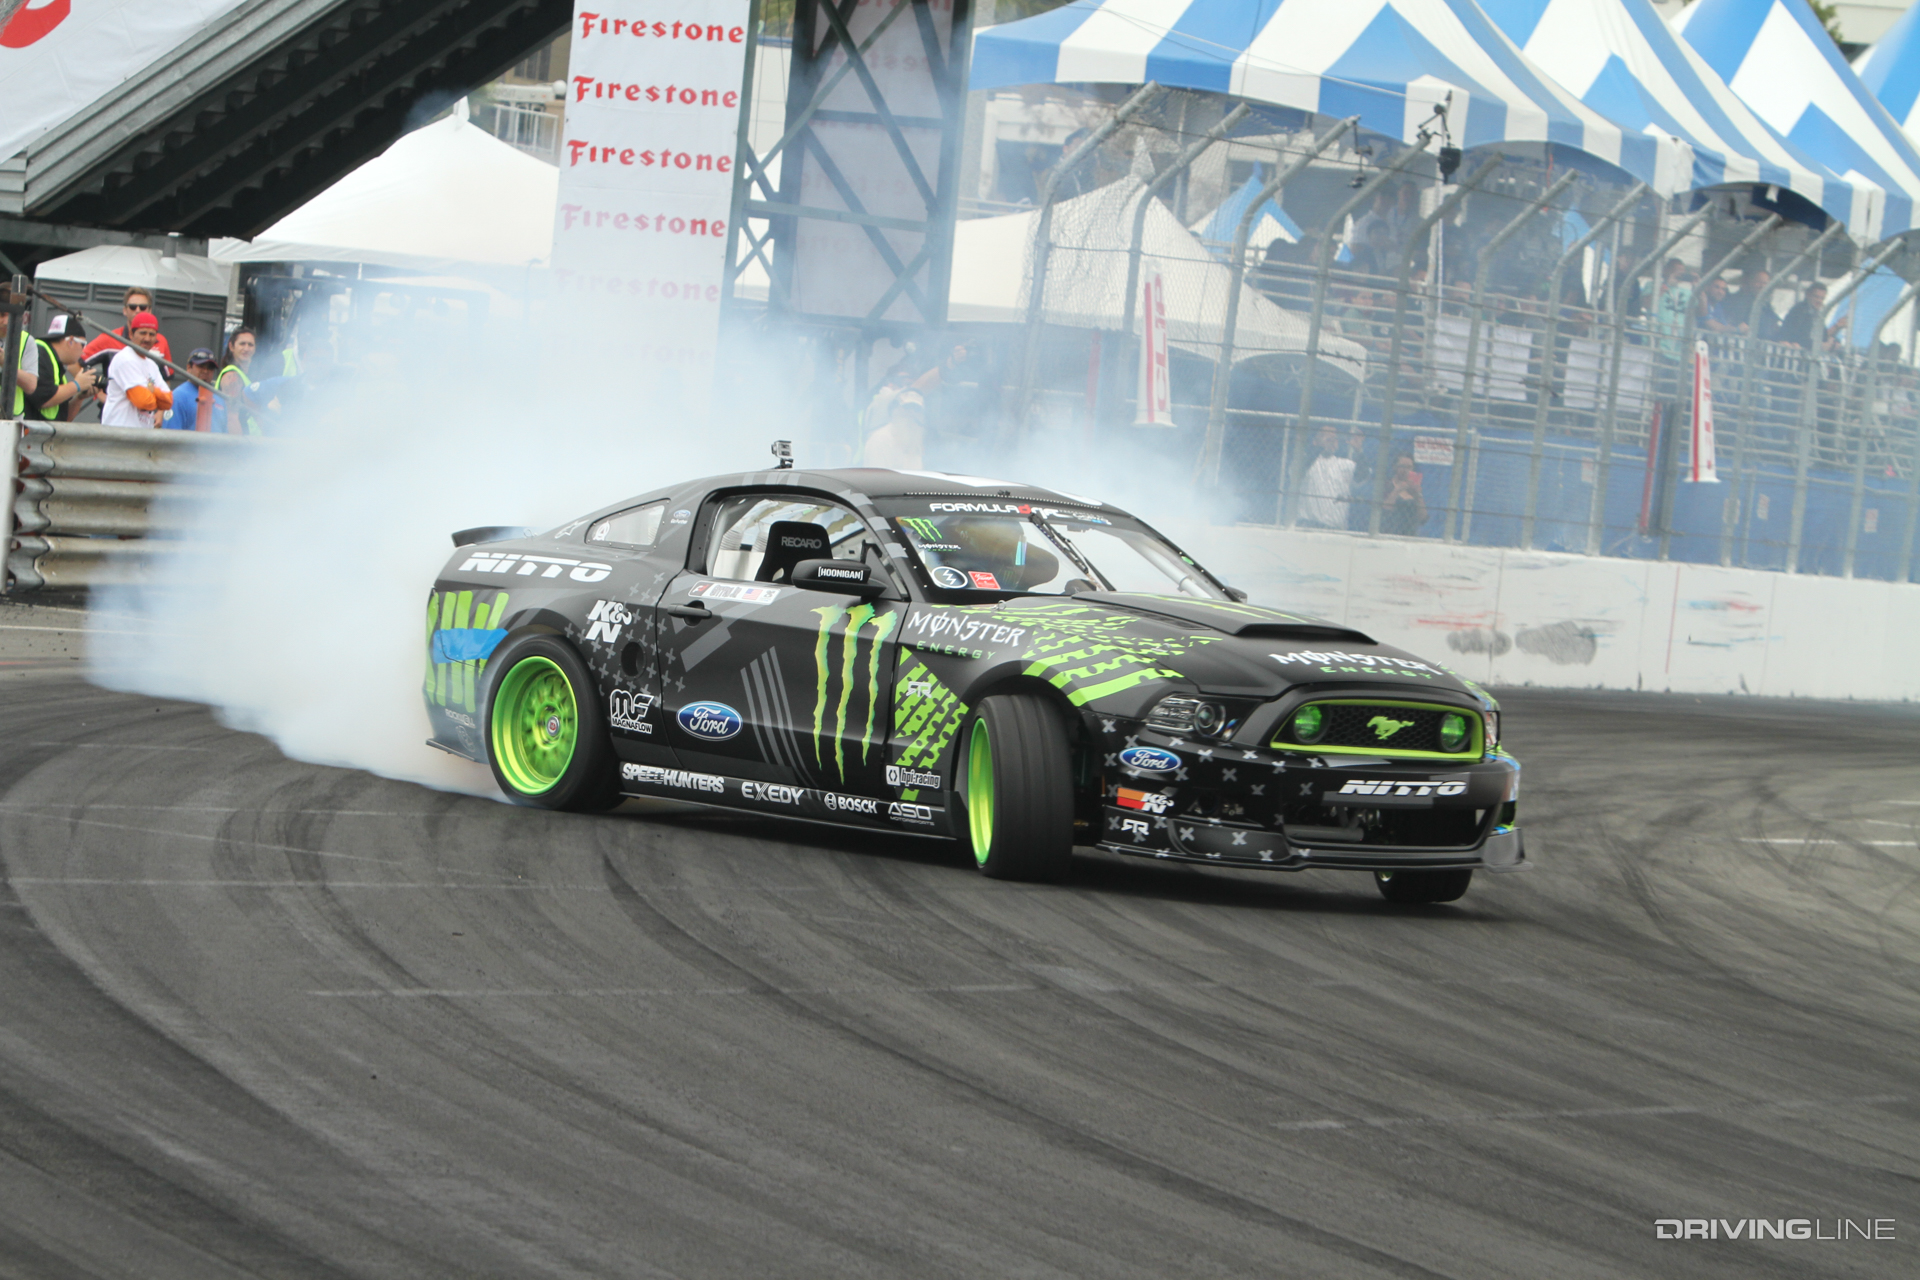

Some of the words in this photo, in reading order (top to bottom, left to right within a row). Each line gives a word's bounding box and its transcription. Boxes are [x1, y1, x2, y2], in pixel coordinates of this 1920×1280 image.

[579, 12, 744, 43] Firestone
[573, 75, 738, 108] Firestone
[567, 139, 732, 173] Firestone
[560, 203, 726, 237] Firestone
[781, 536, 822, 549] RECARO
[458, 552, 612, 582] NITTO
[917, 641, 996, 659] ENERGY
[1320, 666, 1432, 679] ENERGY
[611, 717, 652, 734] MAGNAFLOW
[622, 762, 724, 793] SPEEDHUNTERS
[1338, 779, 1467, 796] NITTO
[741, 781, 804, 805] EXEDY
[837, 796, 878, 814] BOSCH
